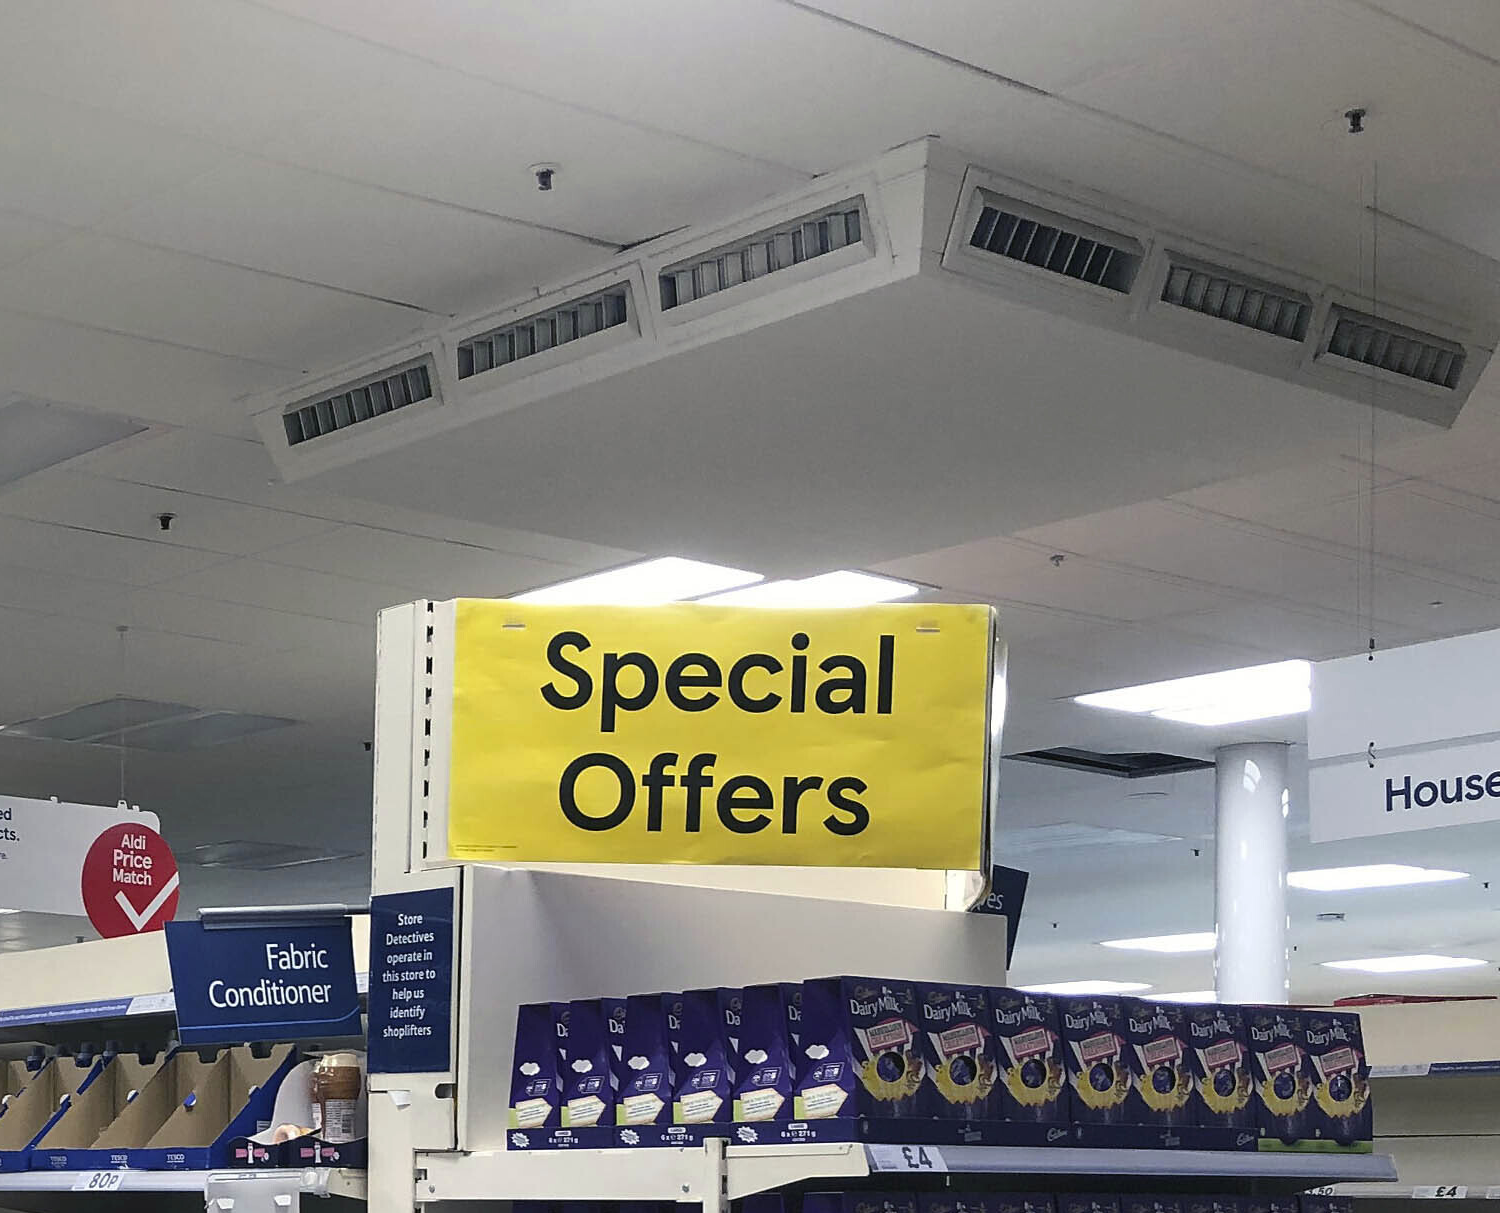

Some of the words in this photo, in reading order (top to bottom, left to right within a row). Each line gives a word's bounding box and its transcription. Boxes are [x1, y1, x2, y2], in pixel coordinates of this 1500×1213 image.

[540, 631, 895, 732] Special
[559, 752, 870, 836] Offers
[121, 834, 146, 849] Aldi
[113, 850, 152, 869] Price
[113, 870, 152, 886] Match
[398, 913, 422, 926] Store
[386, 931, 434, 945] Detectives
[266, 943, 328, 970] Fabric
[387, 951, 420, 964] operate
[422, 951, 432, 961] in
[382, 968, 399, 982] this
[401, 969, 423, 981] store
[425, 968, 436, 980] to
[208, 980, 331, 1008] Conditioner
[392, 987, 412, 1001] help
[413, 988, 424, 999] us
[390, 1005, 425, 1020] identify
[851, 1000, 878, 1018] Dairy
[878, 994, 903, 1015] Milk
[924, 1004, 950, 1021] Dairy
[950, 1000, 976, 1017] Milk
[383, 1024, 431, 1039] shoplifters
[902, 1146, 932, 1169] £4
[1435, 1186, 1457, 1198] £4
